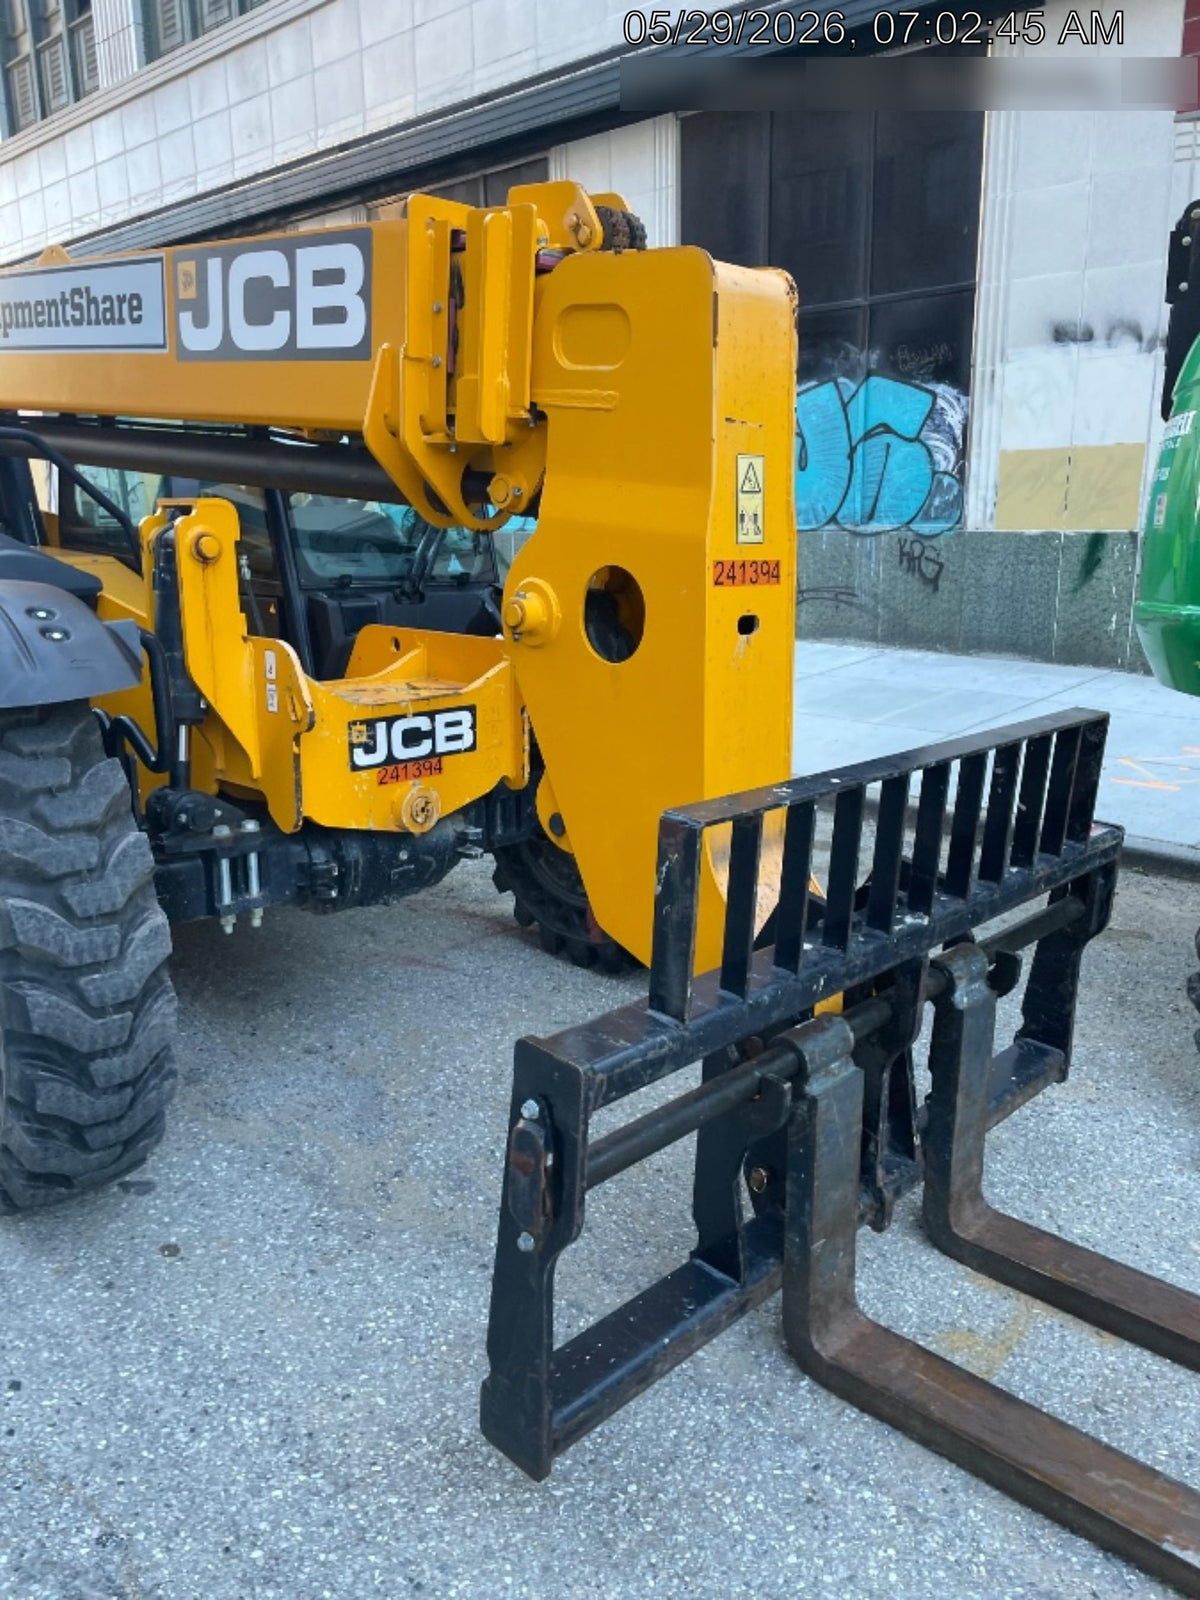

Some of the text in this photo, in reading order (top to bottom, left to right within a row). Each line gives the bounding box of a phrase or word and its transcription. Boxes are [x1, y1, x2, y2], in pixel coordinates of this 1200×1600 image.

[0, 285, 144, 338] pmentShare
[178, 242, 367, 351] JCB
[713, 560, 780, 586] 241394
[352, 709, 474, 767] JCB
[376, 757, 443, 785] 241394
